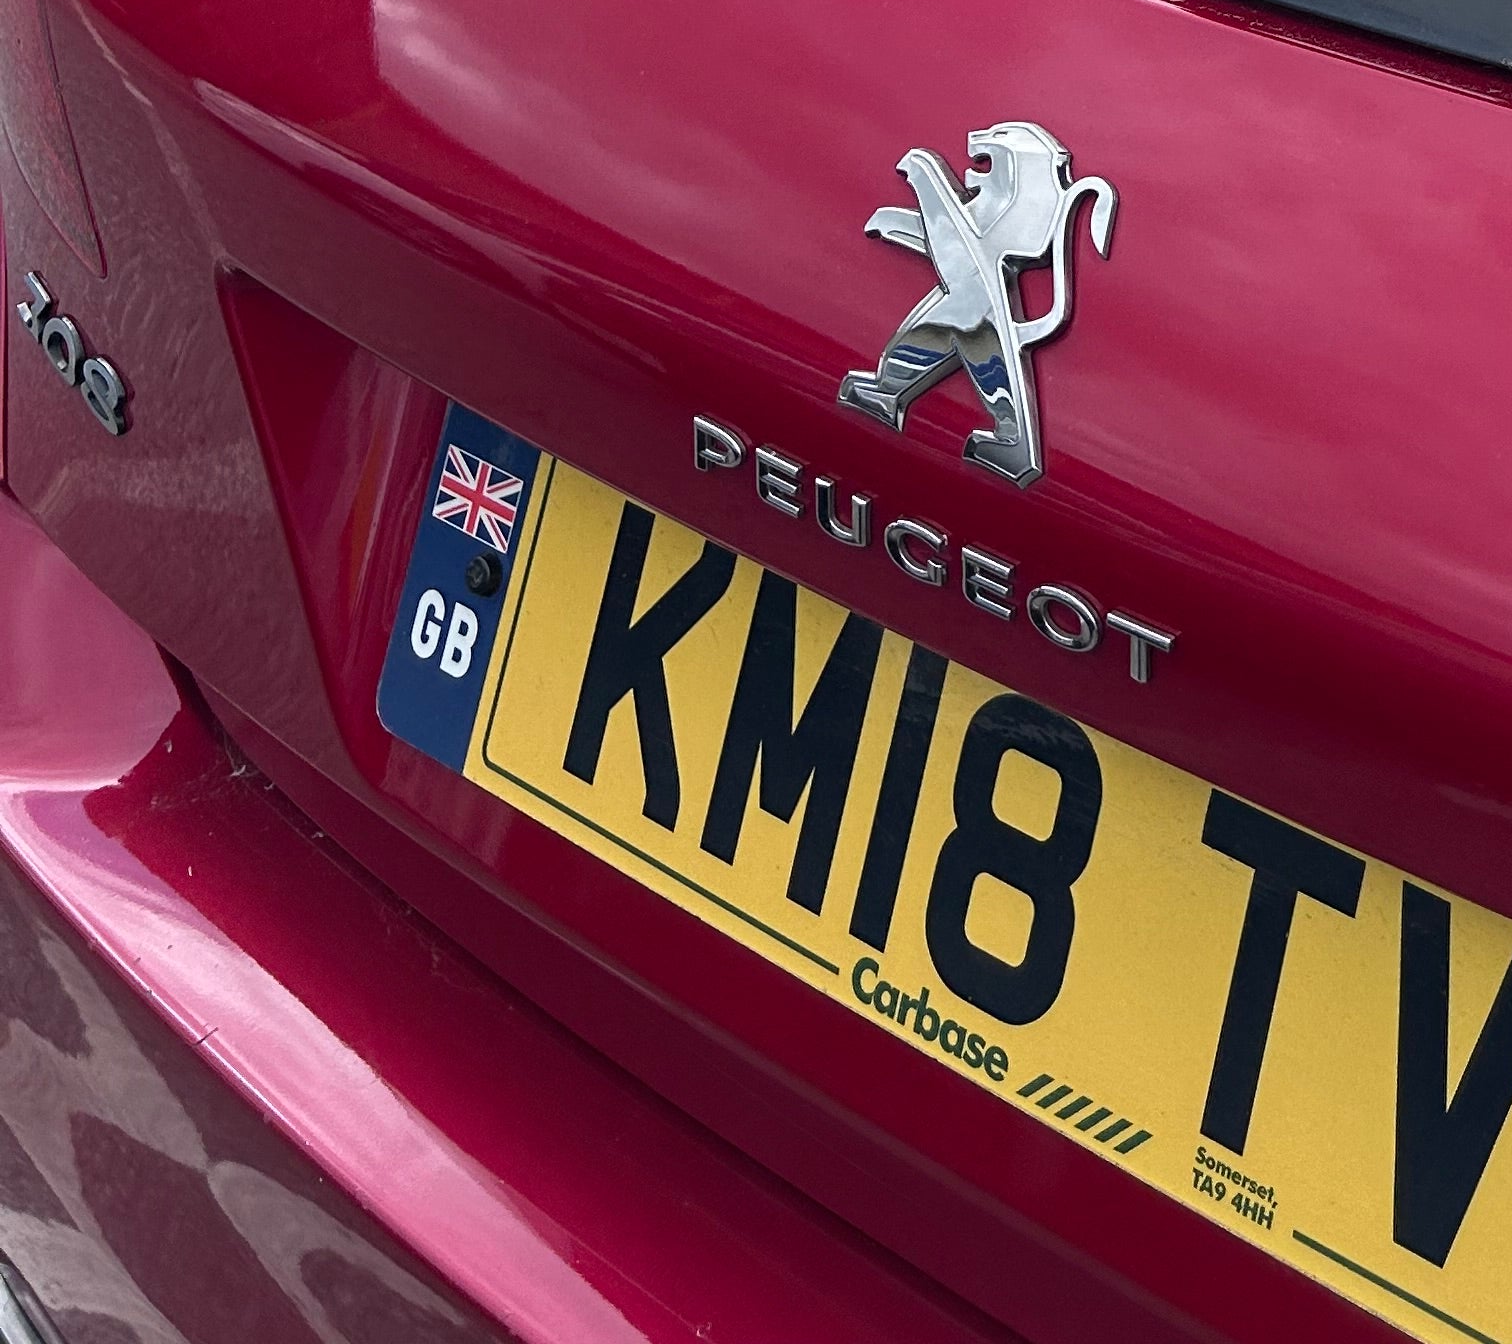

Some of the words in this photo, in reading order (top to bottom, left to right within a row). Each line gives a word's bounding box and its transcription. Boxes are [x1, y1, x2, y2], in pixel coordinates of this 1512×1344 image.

[693, 413, 1176, 685] PEUGEOT
[410, 588, 478, 679] GB
[562, 499, 1103, 1026] KM18
[851, 956, 1009, 1082] Carbase
[1192, 1167, 1227, 1202] TA9
[1230, 1192, 1274, 1231] 4HH
[1195, 1146, 1278, 1209] Somerset,
